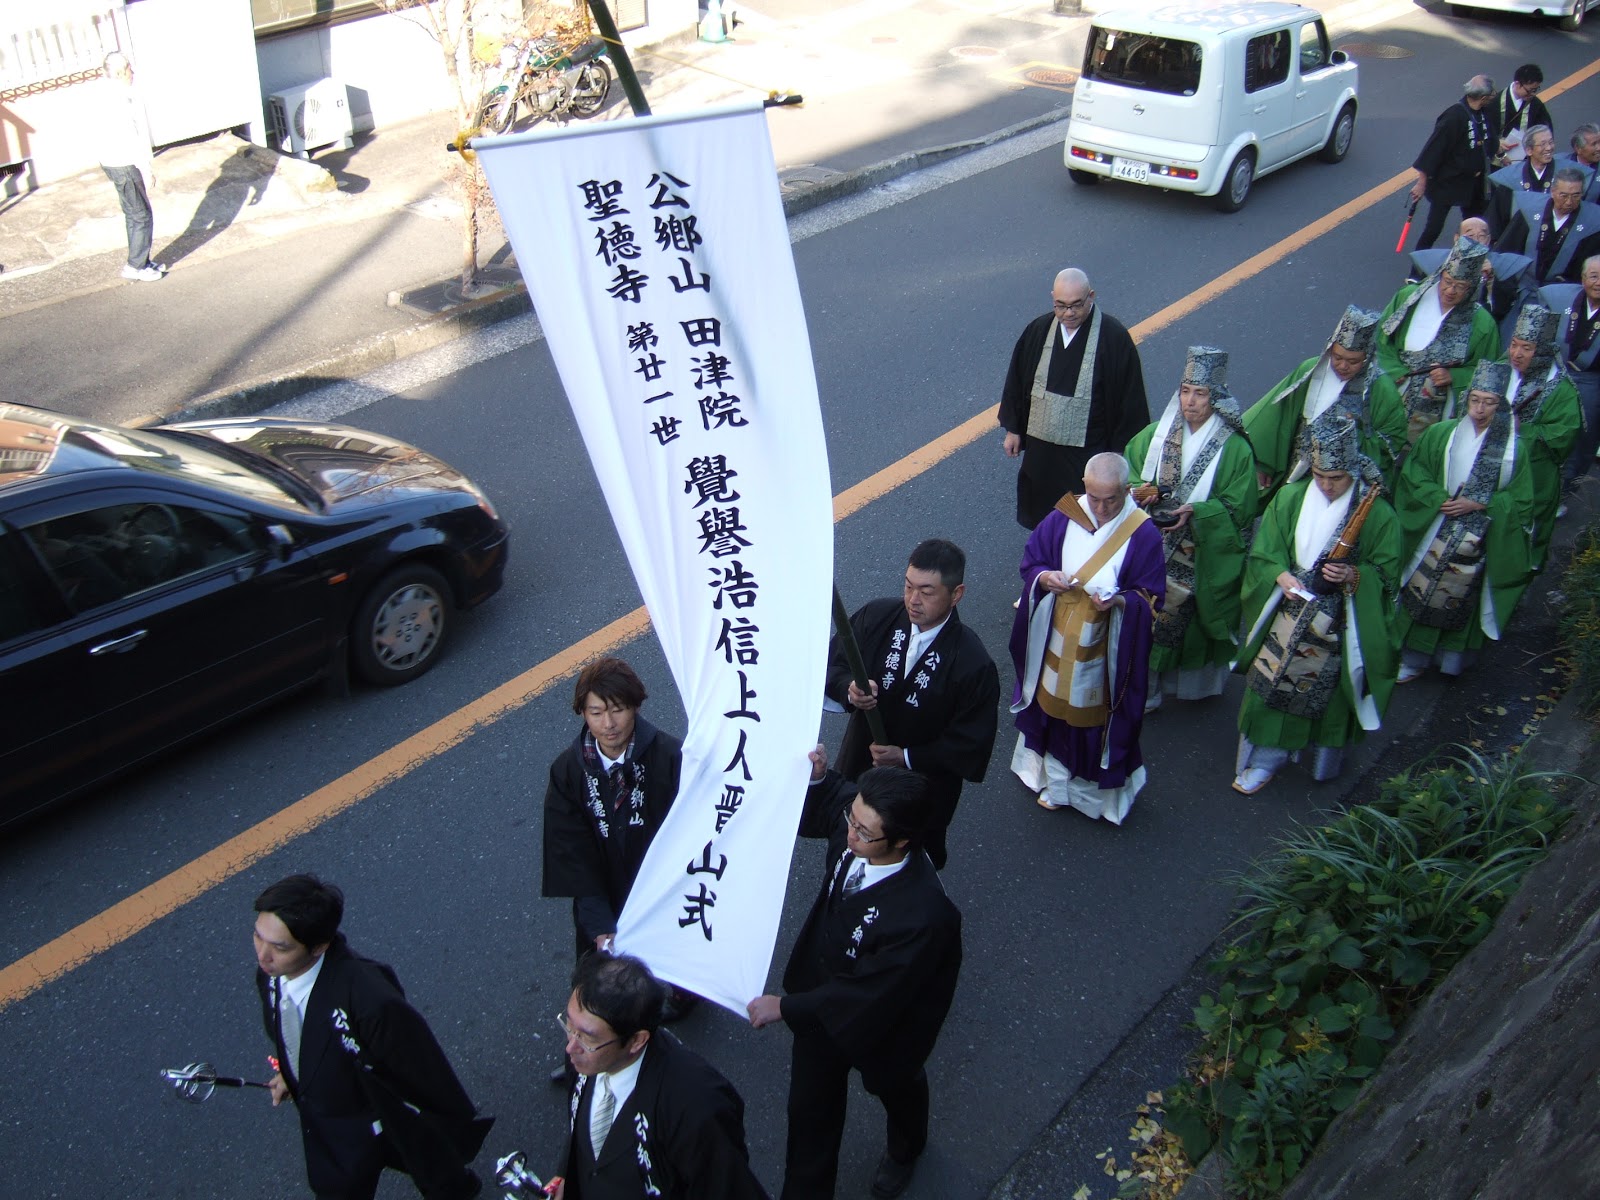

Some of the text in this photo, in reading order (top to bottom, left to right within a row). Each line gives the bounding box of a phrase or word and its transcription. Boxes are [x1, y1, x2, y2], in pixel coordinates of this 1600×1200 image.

[1121, 166, 1147, 180] 44-09
[678, 317, 749, 431] 田津院
